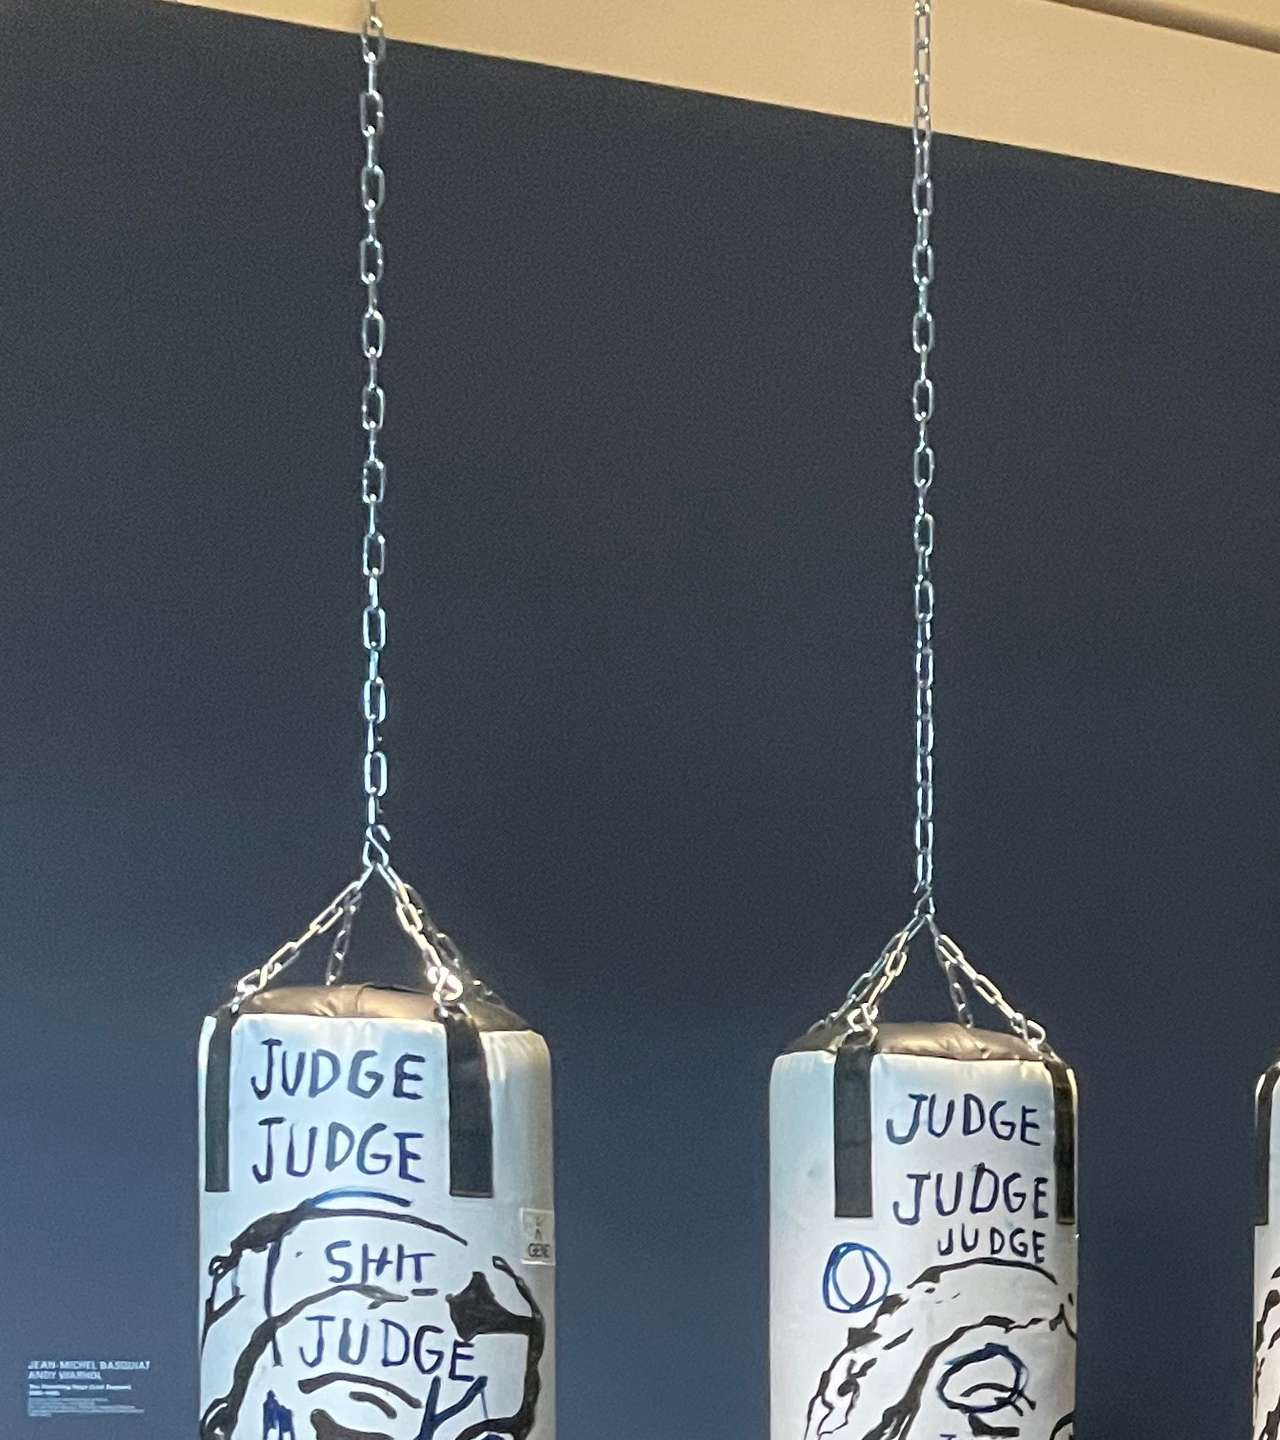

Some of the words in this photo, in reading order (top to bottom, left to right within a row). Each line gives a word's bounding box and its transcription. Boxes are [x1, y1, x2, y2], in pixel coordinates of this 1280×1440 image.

[250, 1038, 427, 1100] JUDGE
[251, 1116, 426, 1184] JUDGE
[885, 1092, 1042, 1147] JUDGE
[892, 1161, 1050, 1227] JUDGE
[937, 1222, 1047, 1265] JUDGE
[299, 1314, 476, 1382] JUDGE
